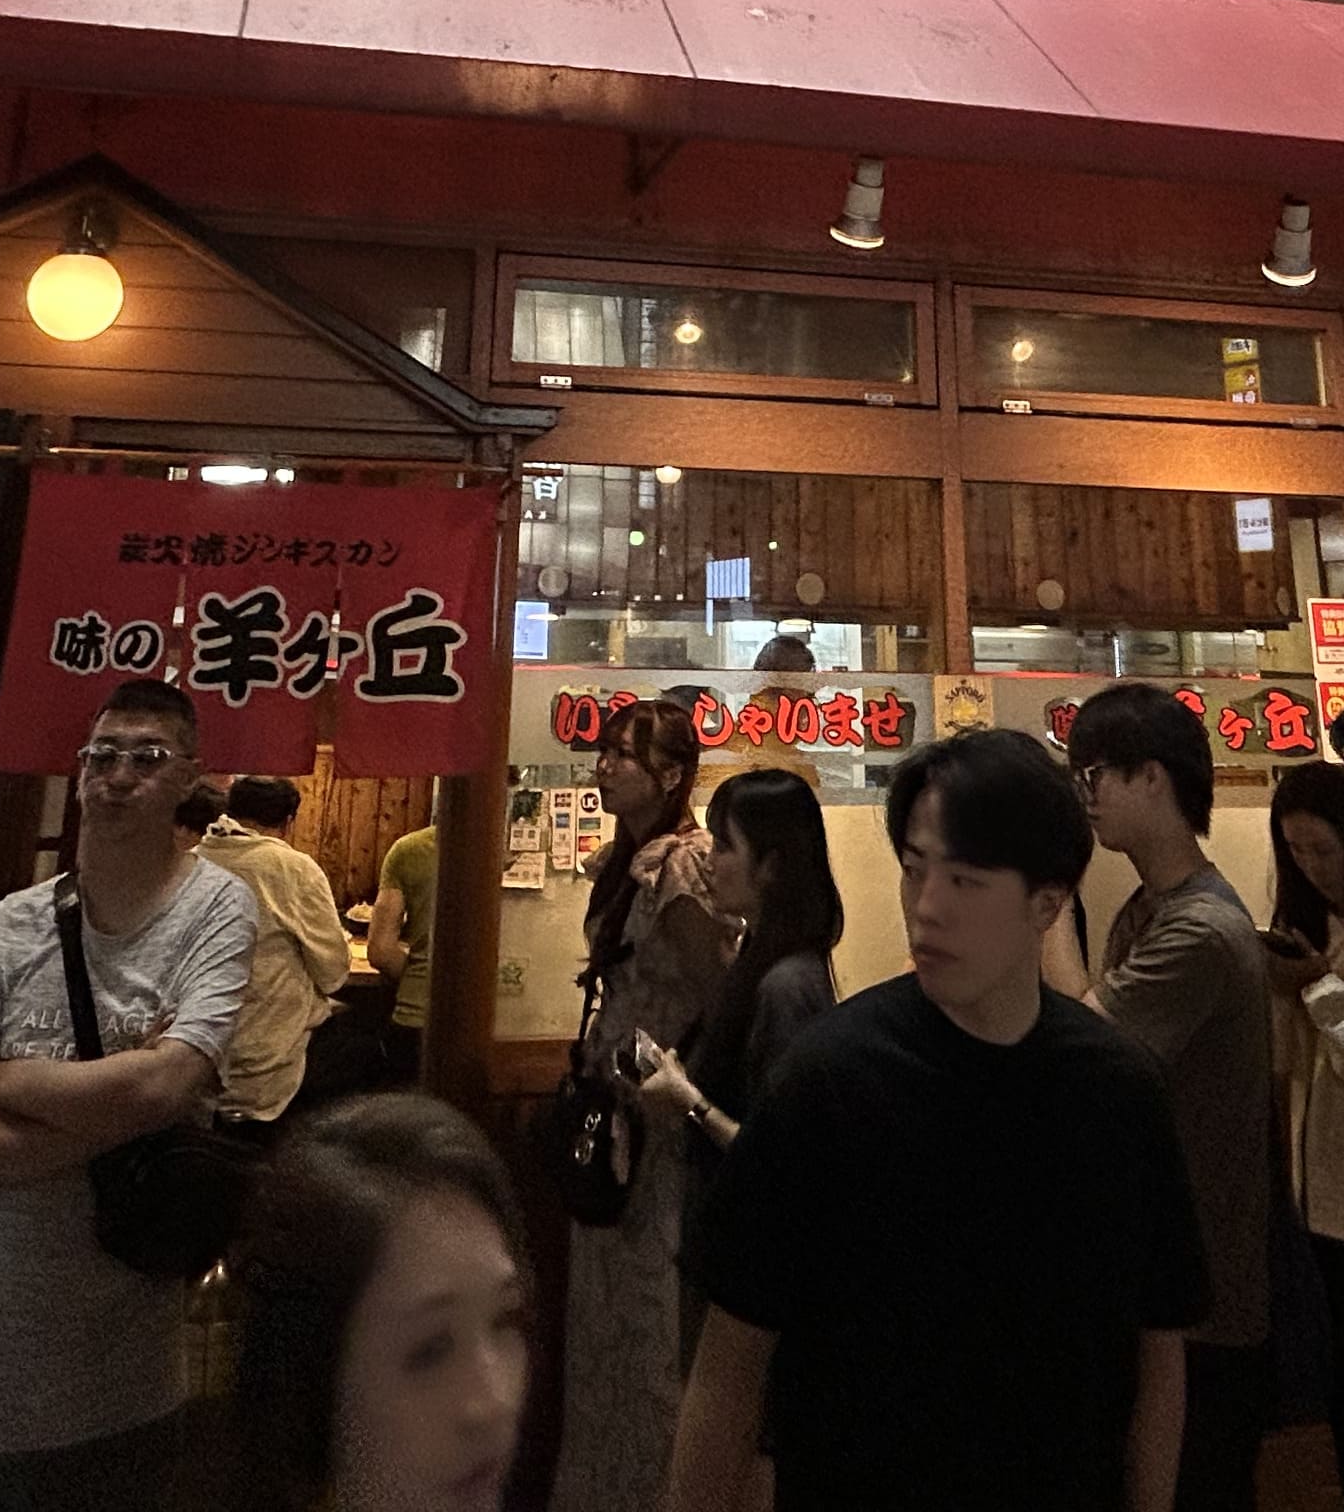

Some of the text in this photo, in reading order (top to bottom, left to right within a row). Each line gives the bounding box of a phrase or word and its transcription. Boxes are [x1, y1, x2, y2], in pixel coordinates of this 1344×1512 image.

[50, 586, 467, 708] 味の羊ヶ丘
[553, 690, 906, 747] いしゃいませ
